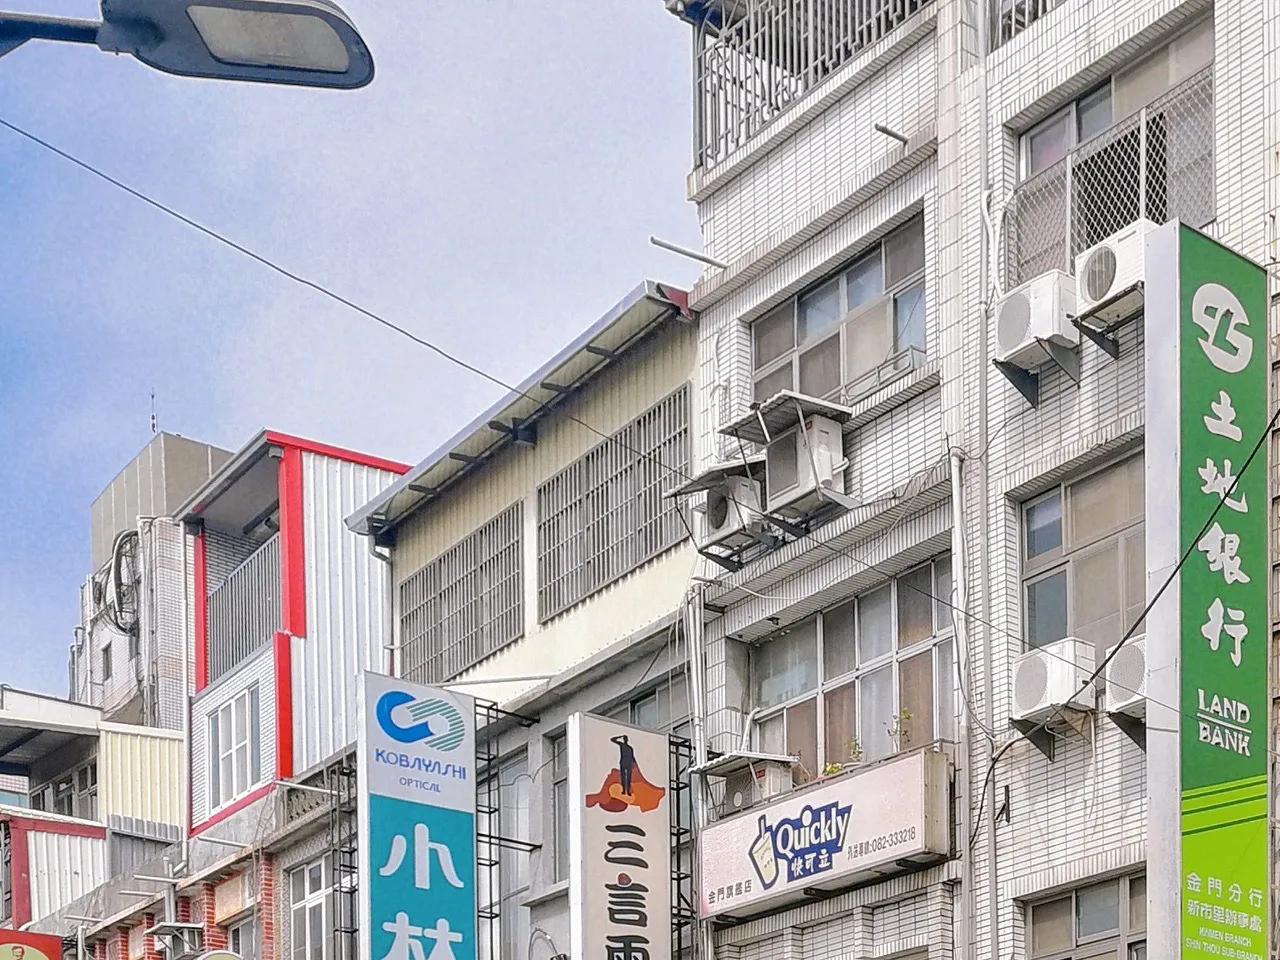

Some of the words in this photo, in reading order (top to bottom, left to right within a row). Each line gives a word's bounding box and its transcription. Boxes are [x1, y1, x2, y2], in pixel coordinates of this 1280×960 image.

[1198, 389, 1250, 668] 土地銀行
[1197, 689, 1251, 723] LAND
[1198, 722, 1250, 757] BANK
[374, 748, 467, 780] KOBAYASHI
[399, 777, 441, 793] OPTICAL
[776, 807, 849, 860] Quickly
[791, 848, 832, 877] 快可立
[708, 880, 752, 904] 金門旗艦店
[1187, 872, 1262, 908] 金門分行
[1187, 899, 1262, 932] 新市里辦事處
[1200, 926, 1223, 941] KINMEN
[1225, 932, 1251, 948] BRANCH
[1203, 942, 1220, 954] THOU
